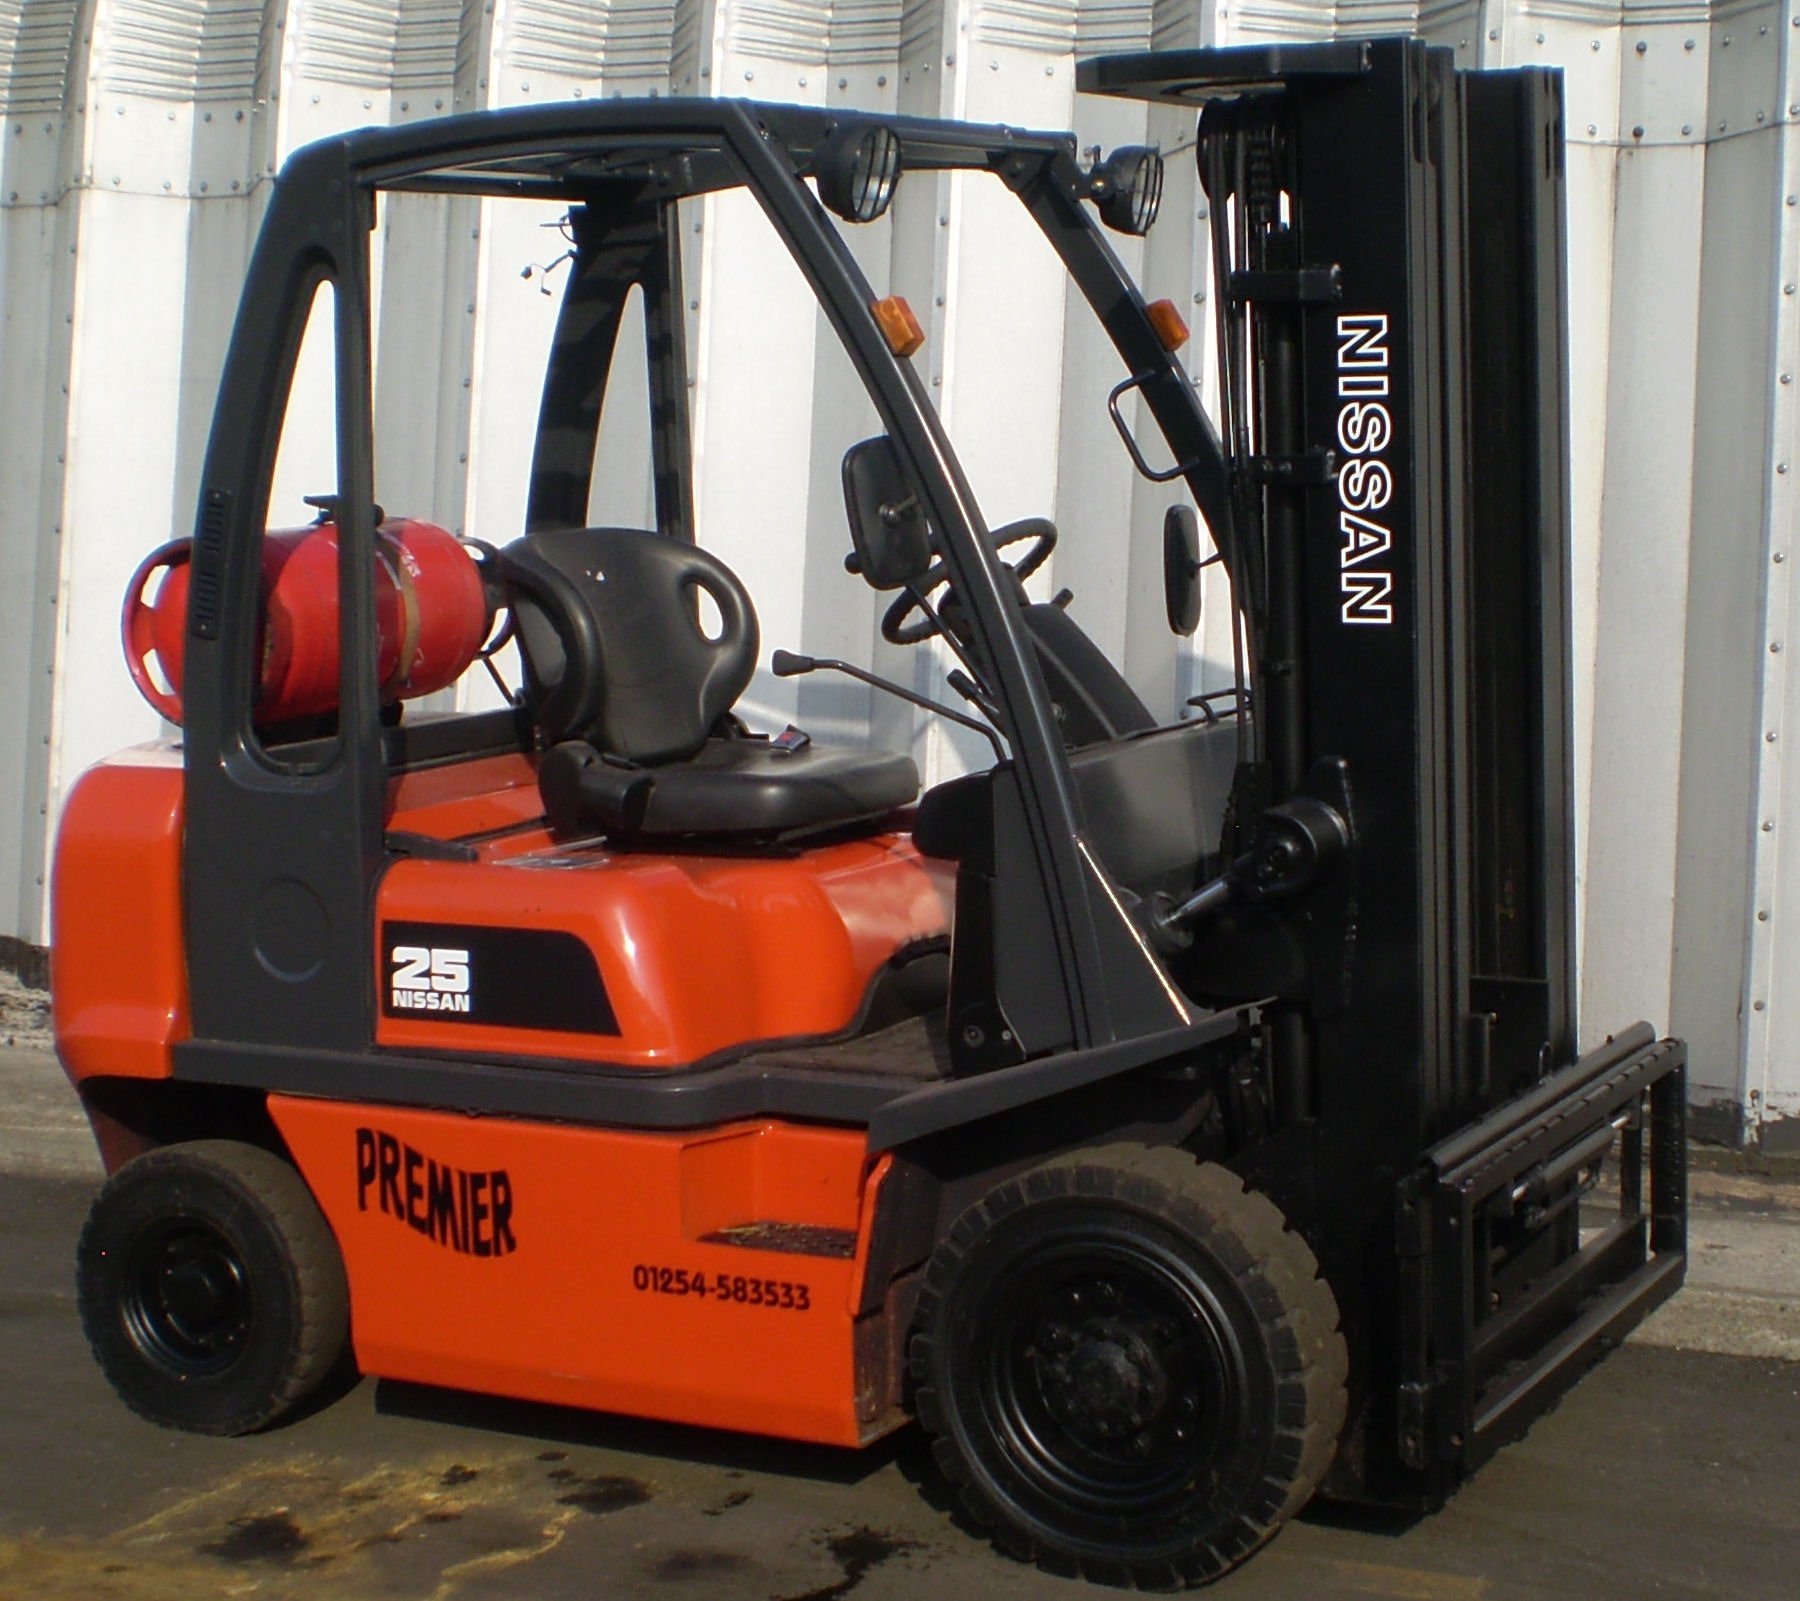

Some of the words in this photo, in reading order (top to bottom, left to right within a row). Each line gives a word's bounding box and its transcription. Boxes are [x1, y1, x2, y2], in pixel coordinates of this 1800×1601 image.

[1337, 314, 1392, 624] NISSAN
[392, 946, 470, 993] 25
[392, 989, 470, 1012] NISSAN
[356, 1127, 517, 1258] PREMIER
[633, 1264, 811, 1311] 01254-583533
